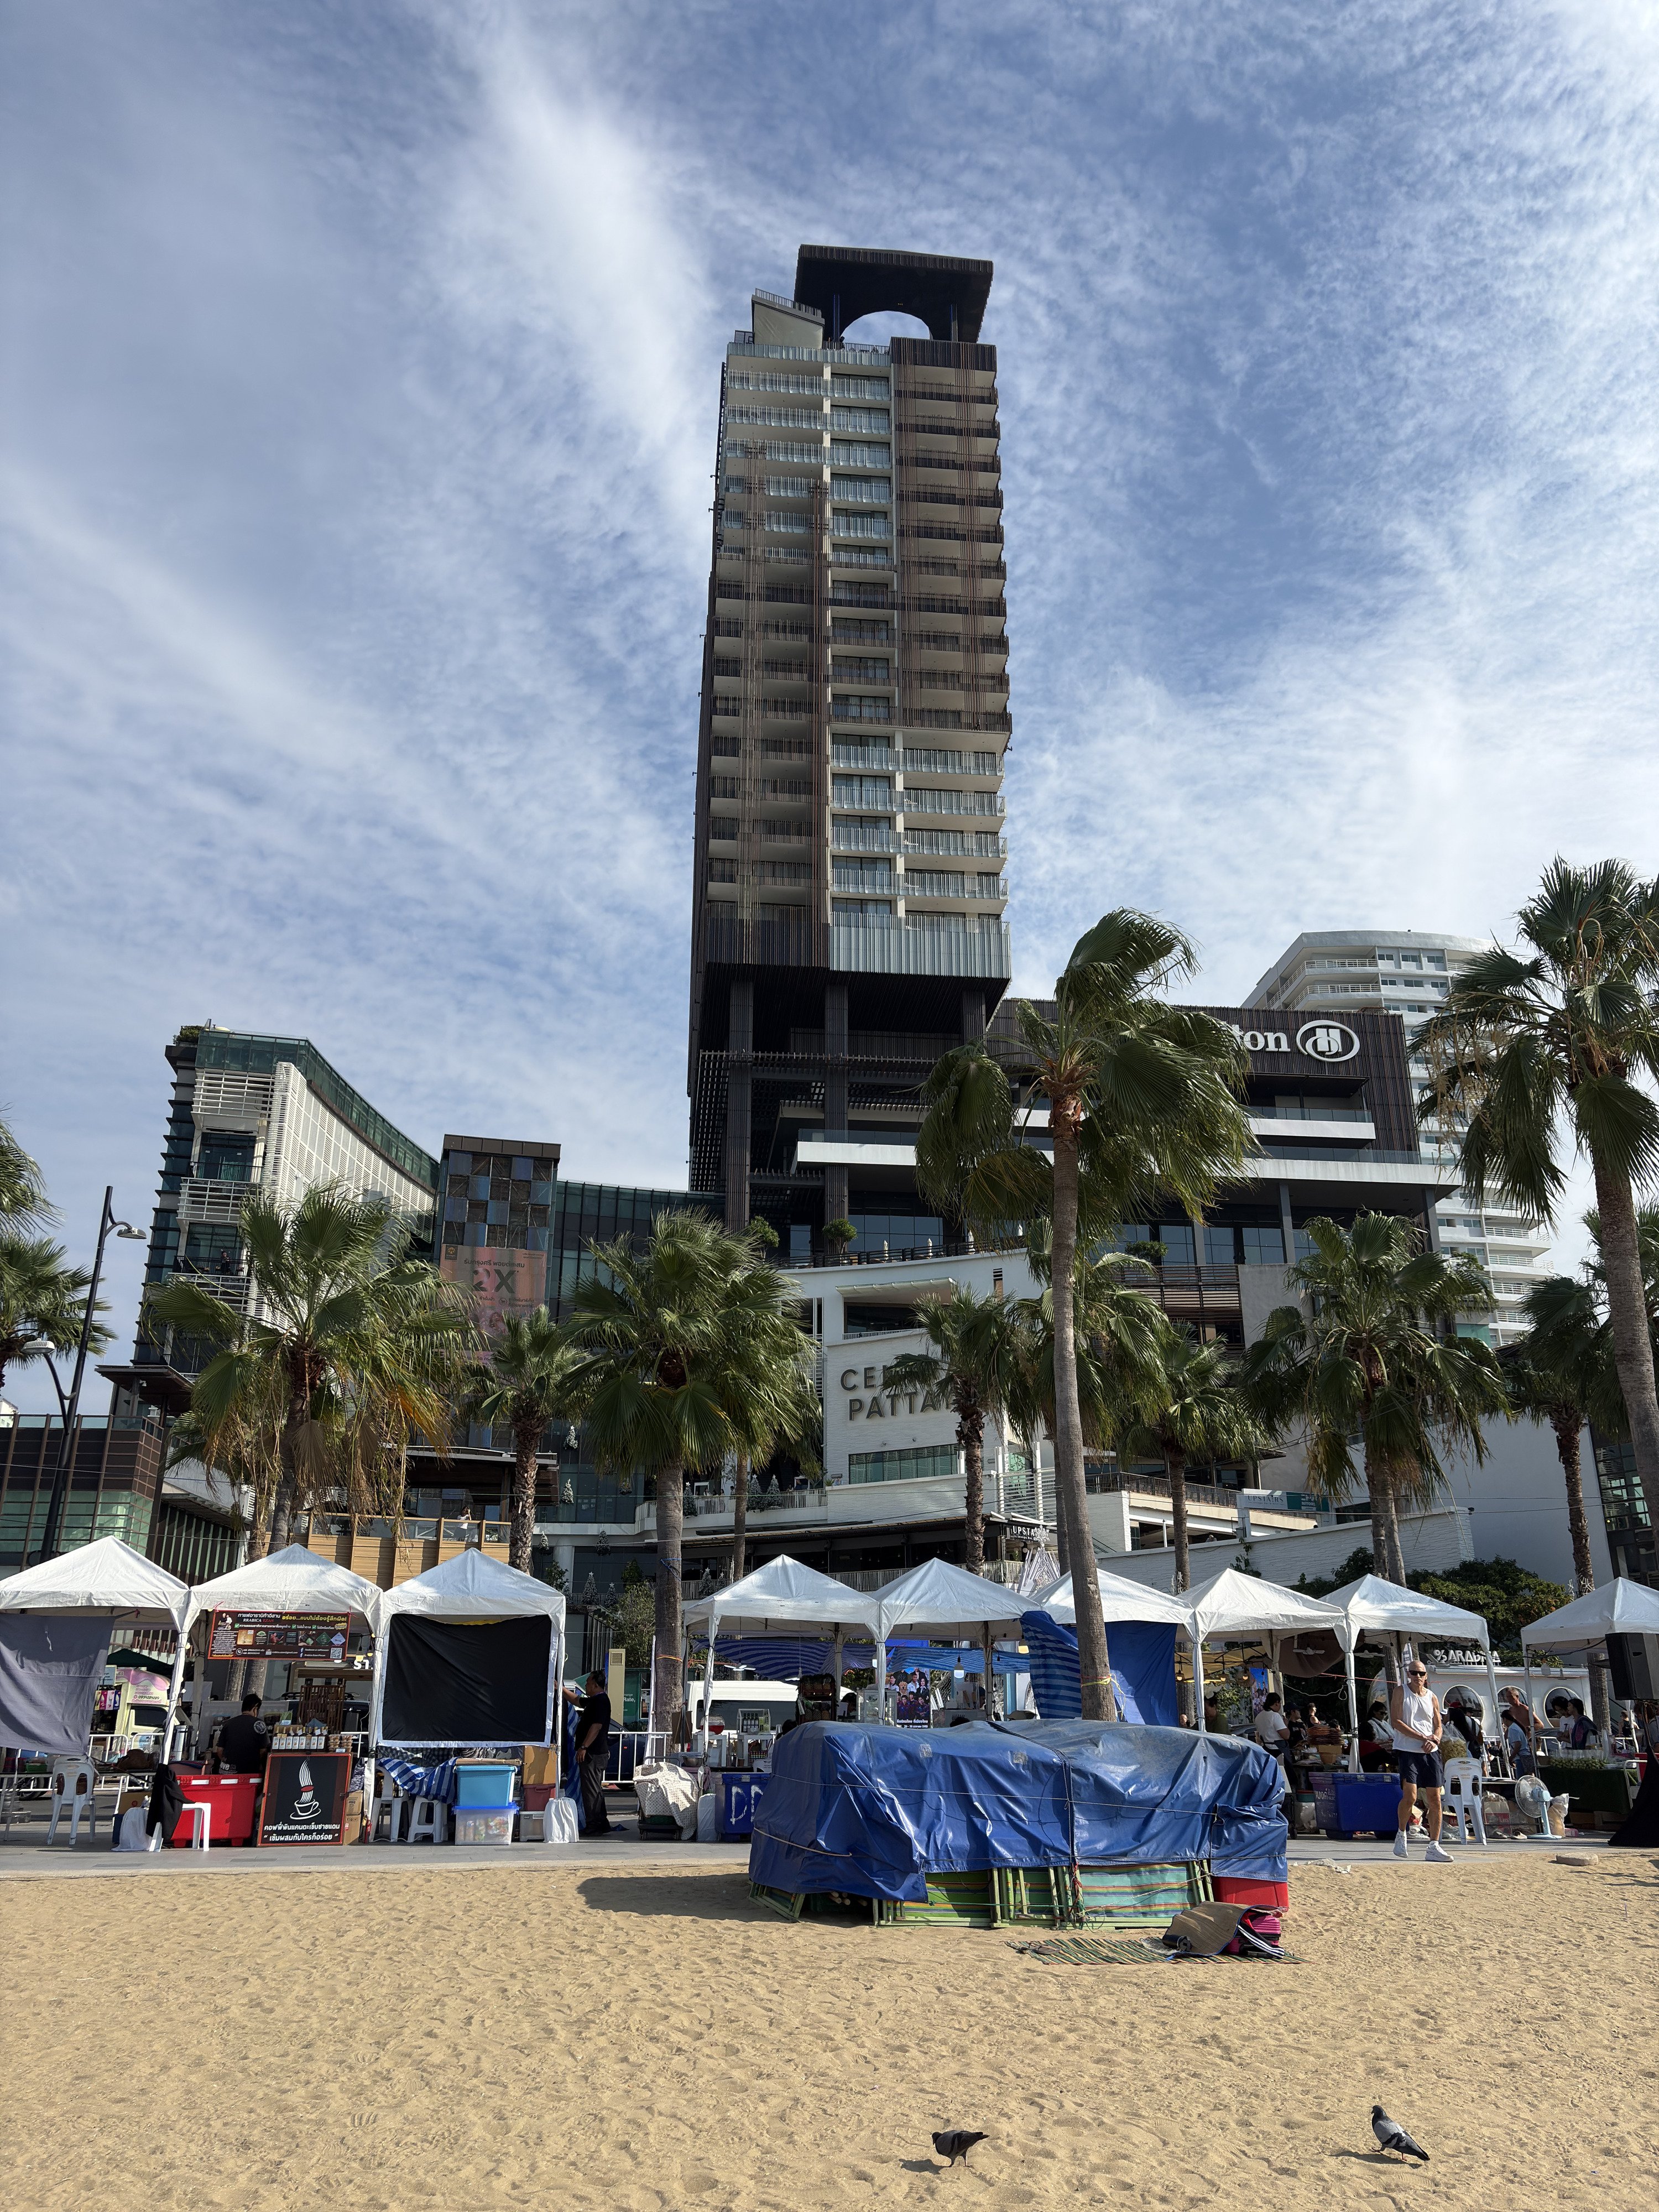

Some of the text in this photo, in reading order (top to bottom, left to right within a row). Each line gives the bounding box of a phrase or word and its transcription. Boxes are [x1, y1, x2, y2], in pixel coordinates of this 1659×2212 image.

[1232, 1024, 1291, 1052] ton
[849, 1390, 954, 1421] PATTAY
[1013, 1526, 1035, 1536] UPSTA
[1448, 1650, 1501, 1663] ARABIA
